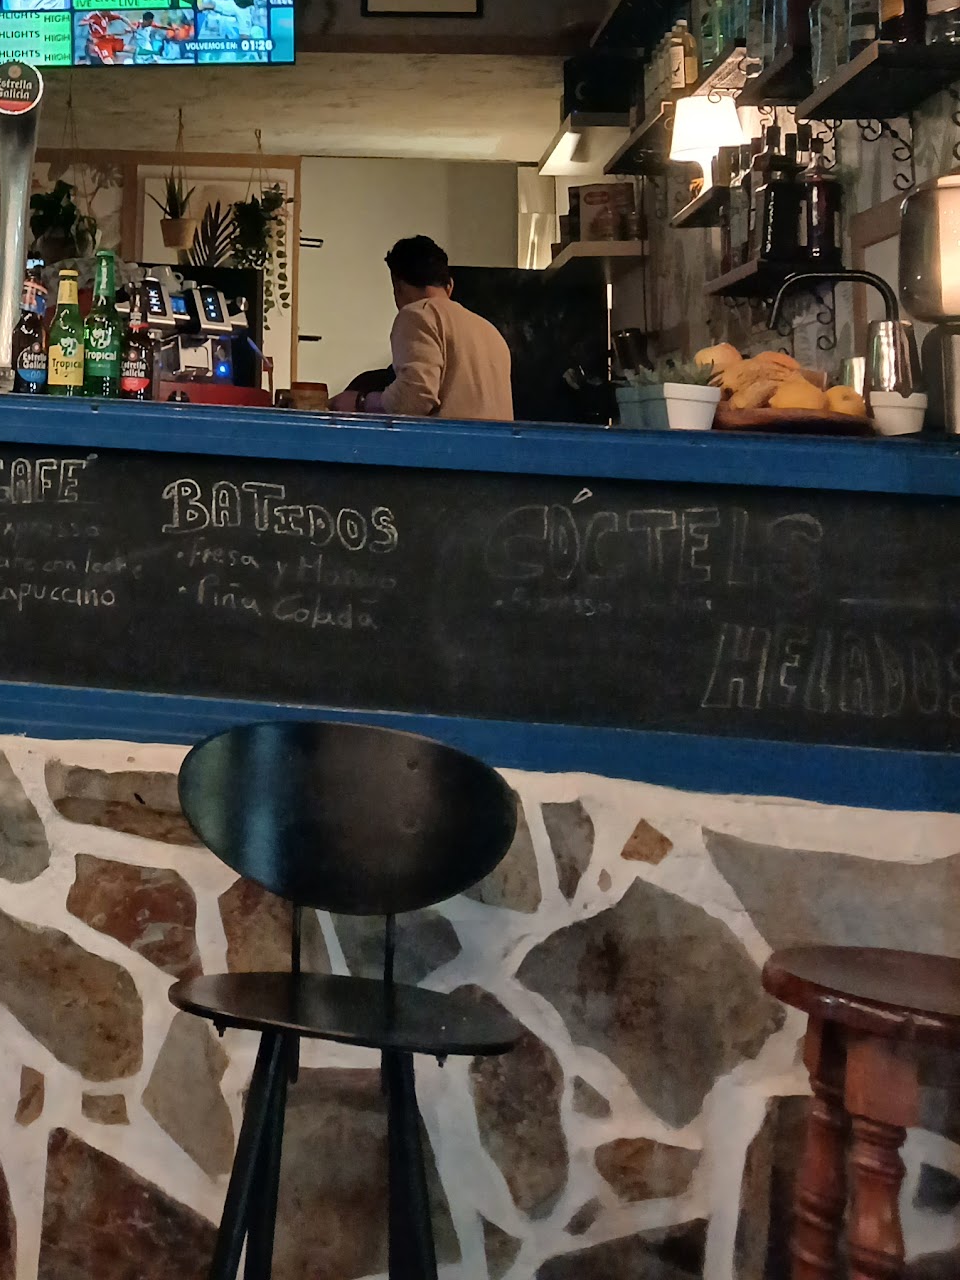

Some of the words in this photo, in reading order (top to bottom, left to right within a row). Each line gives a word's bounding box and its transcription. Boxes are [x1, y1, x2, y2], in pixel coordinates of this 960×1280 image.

[119, 0, 139, 7] LIVE
[185, 42, 225, 51] VOLVEMOS
[85, 350, 117, 362] Tropical
[52, 358, 83, 370] Tropica
[161, 478, 398, 554] BATIDOS
